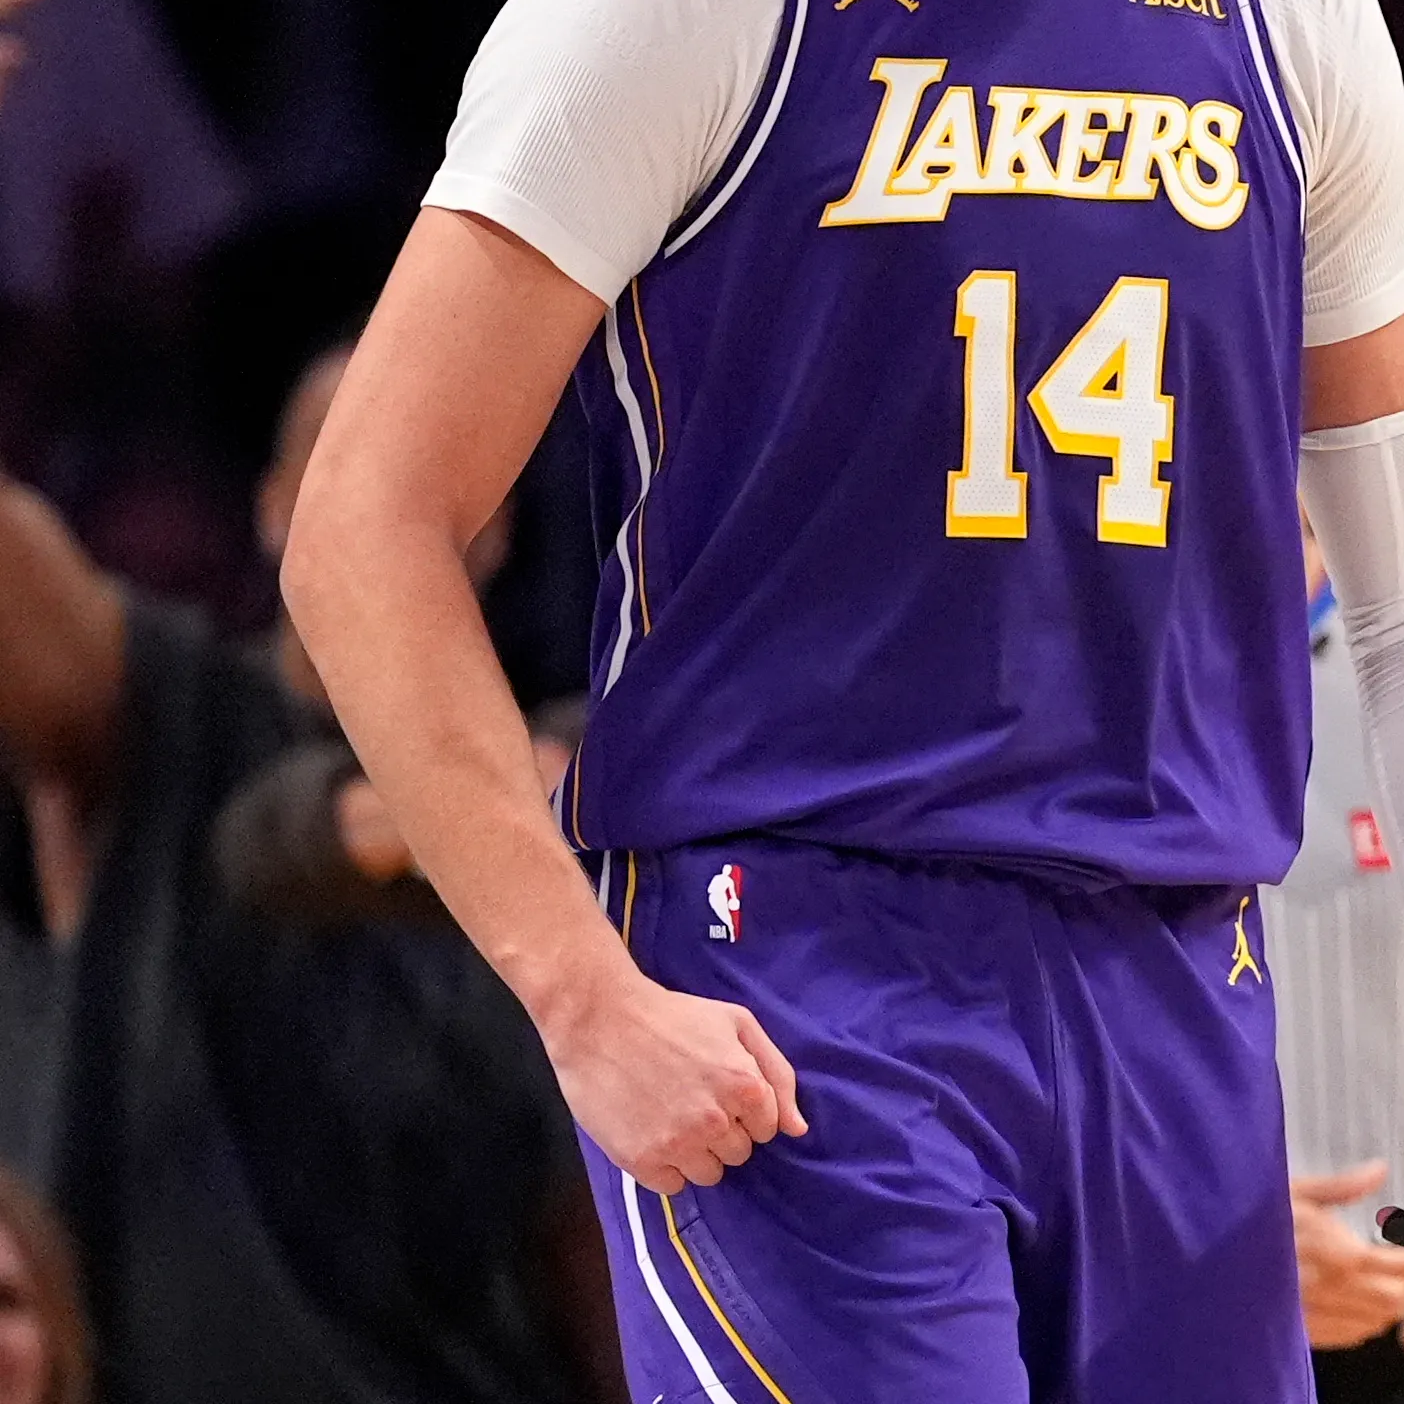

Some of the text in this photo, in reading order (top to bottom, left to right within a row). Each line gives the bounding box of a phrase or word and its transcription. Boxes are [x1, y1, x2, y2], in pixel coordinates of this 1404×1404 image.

[818, 58, 1249, 230] LAKERS
[946, 269, 1174, 547] 14
[709, 924, 728, 940] NBA
